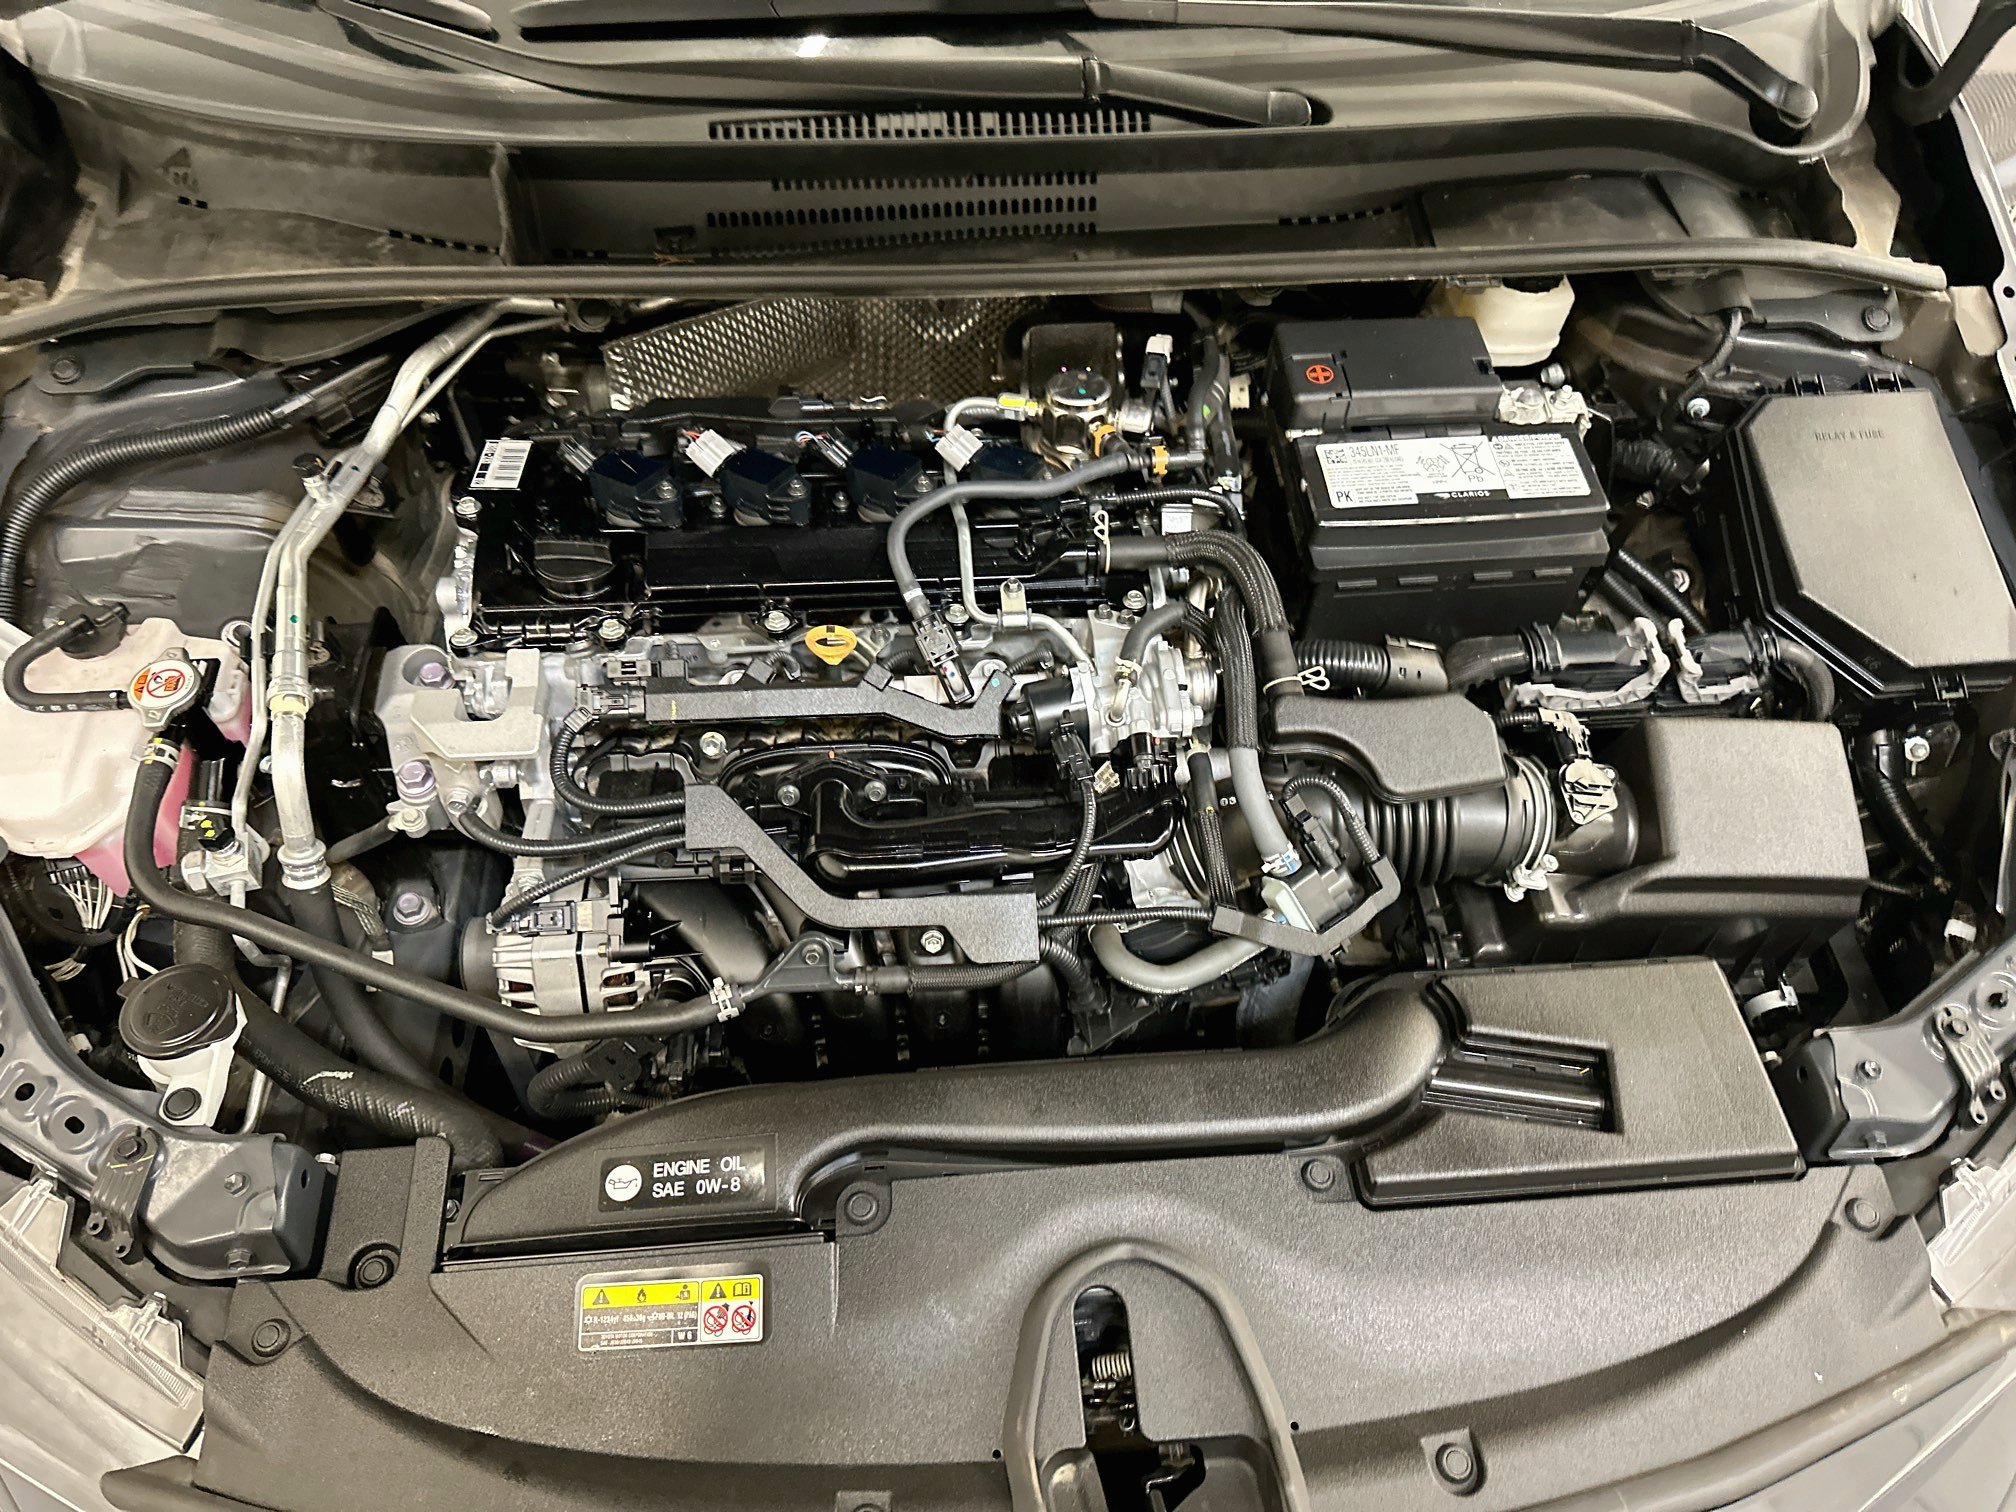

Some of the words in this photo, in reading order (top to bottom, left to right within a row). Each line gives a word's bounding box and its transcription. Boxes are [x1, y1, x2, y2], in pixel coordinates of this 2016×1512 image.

[1349, 444, 1399, 457] 345LN1-MF
[1467, 474, 1484, 483] Pb
[1336, 490, 1353, 502] PK
[1450, 490, 1490, 498] CLARIOS
[653, 1158, 710, 1178] ENGINE
[720, 1155, 746, 1172] OIL
[652, 1181, 685, 1198] SAE
[696, 1176, 741, 1194] 0W-8
